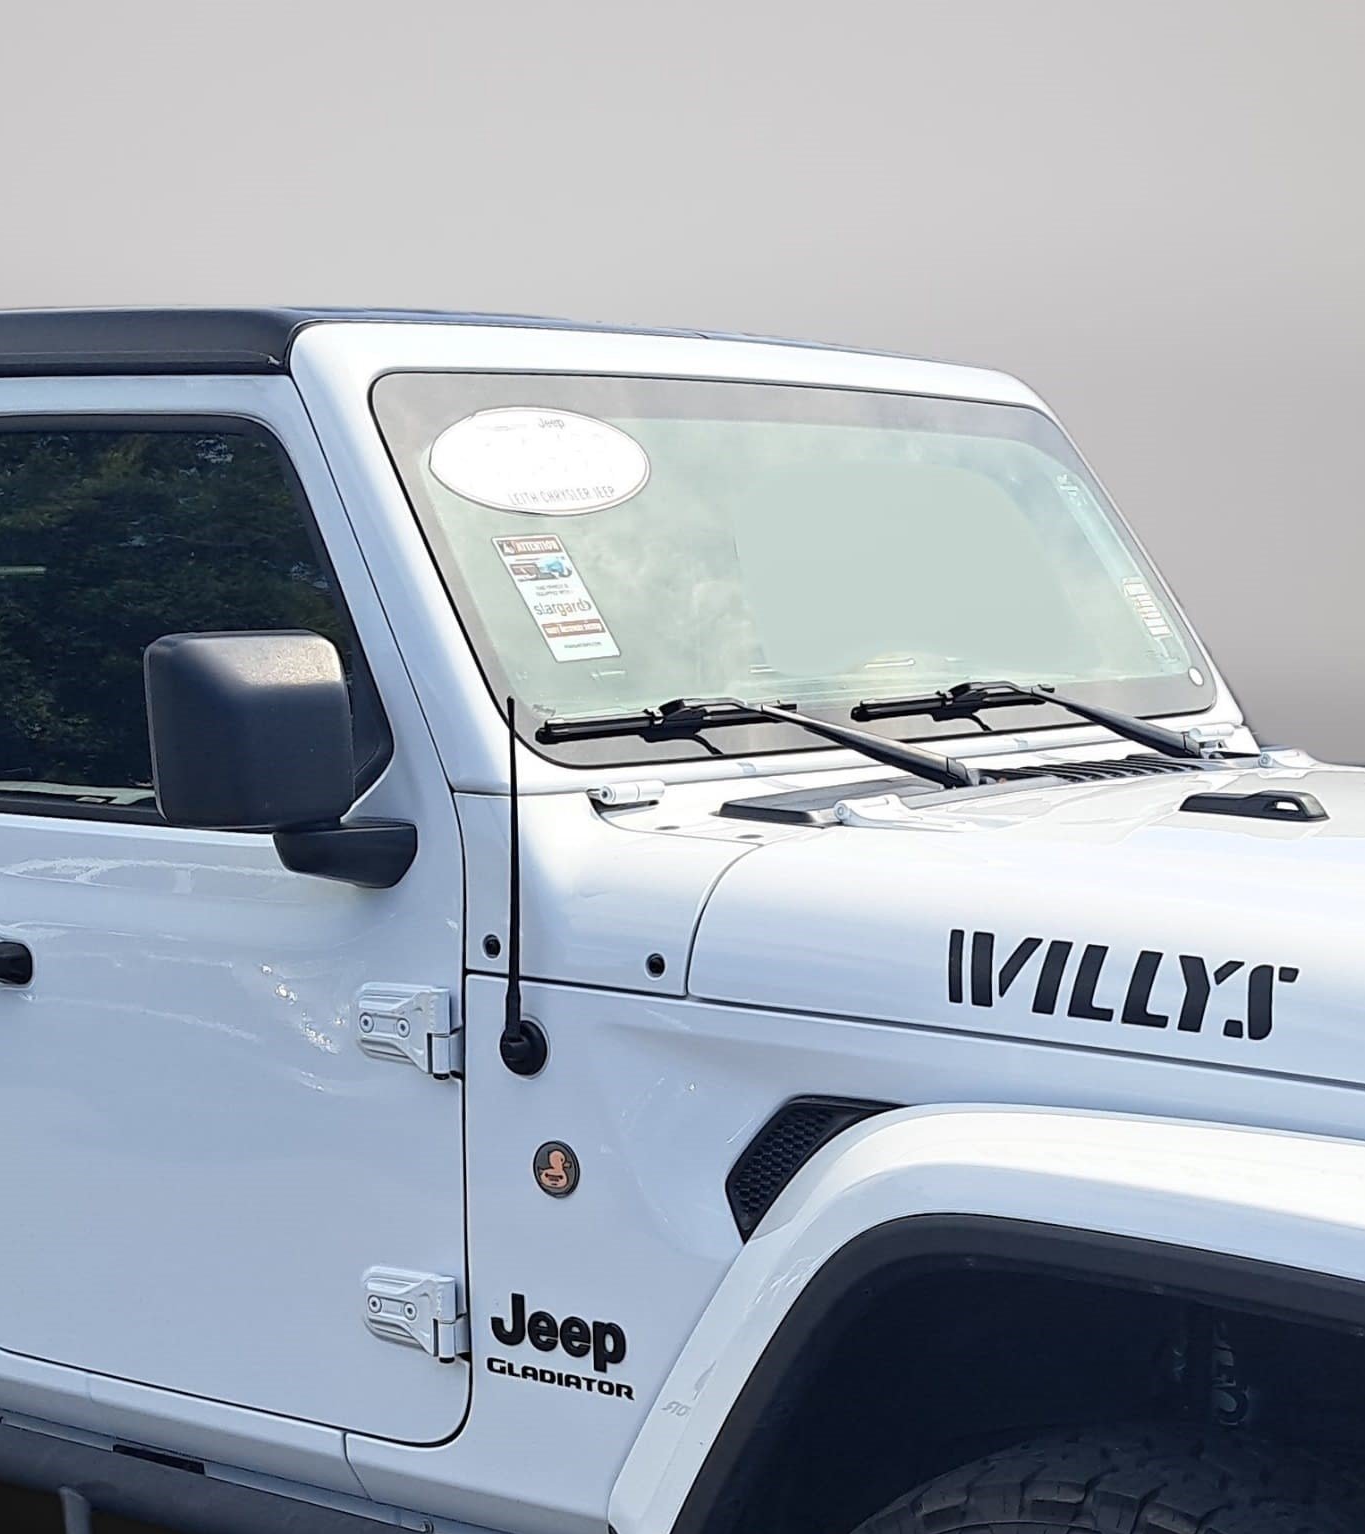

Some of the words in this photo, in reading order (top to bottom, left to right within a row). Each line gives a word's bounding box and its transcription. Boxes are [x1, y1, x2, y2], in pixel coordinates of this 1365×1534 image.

[949, 929, 1299, 1040] WILLYS
[490, 1293, 626, 1374] Jeep
[487, 1357, 635, 1400] GLADIATOR
